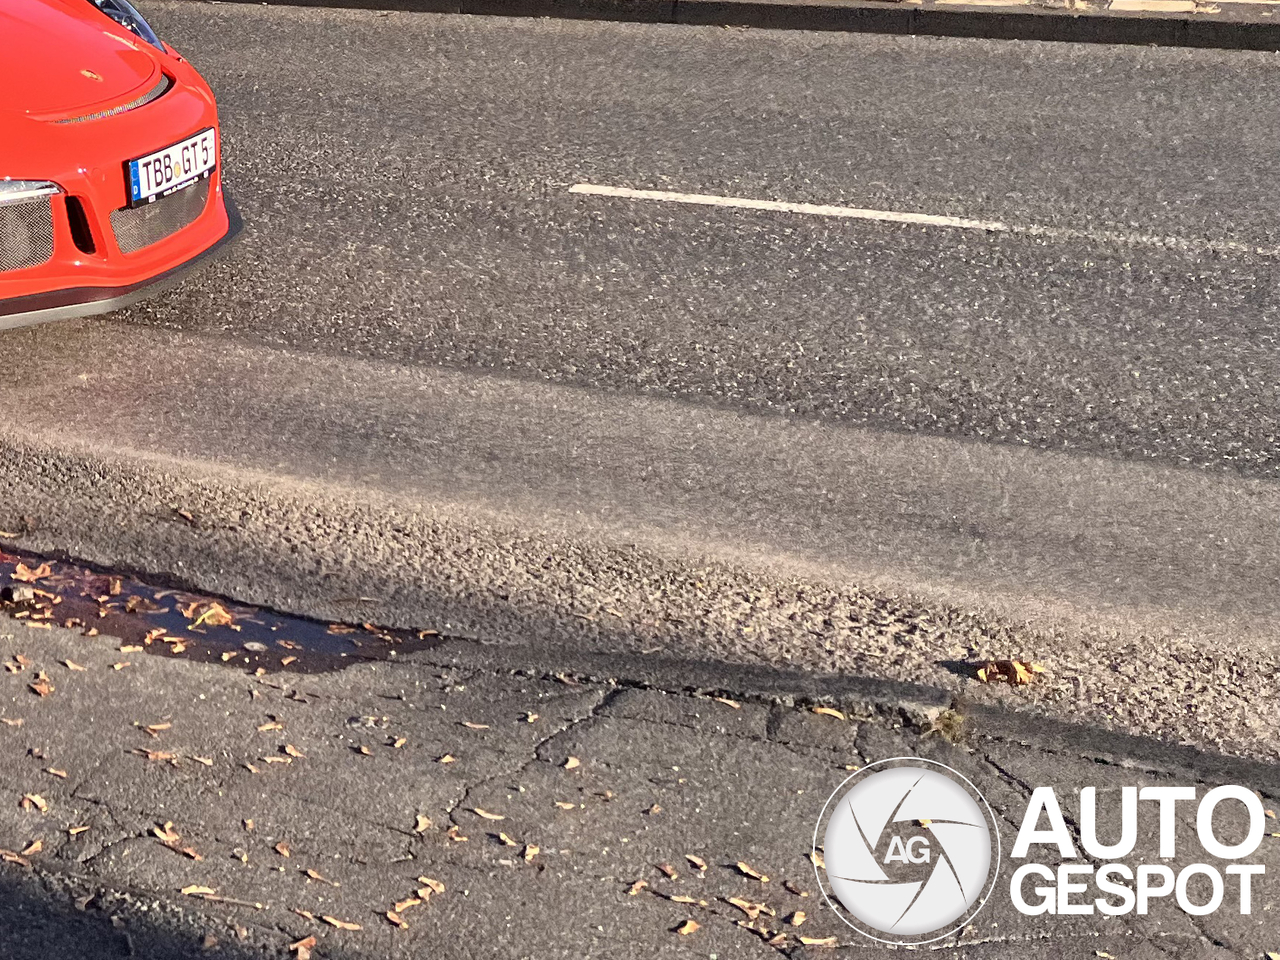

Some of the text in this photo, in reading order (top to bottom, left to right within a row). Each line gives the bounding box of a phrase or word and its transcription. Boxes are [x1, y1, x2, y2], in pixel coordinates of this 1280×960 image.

[142, 153, 173, 191] TBB
[181, 141, 198, 175] GT
[201, 136, 209, 166] 5
[133, 185, 138, 195] D
